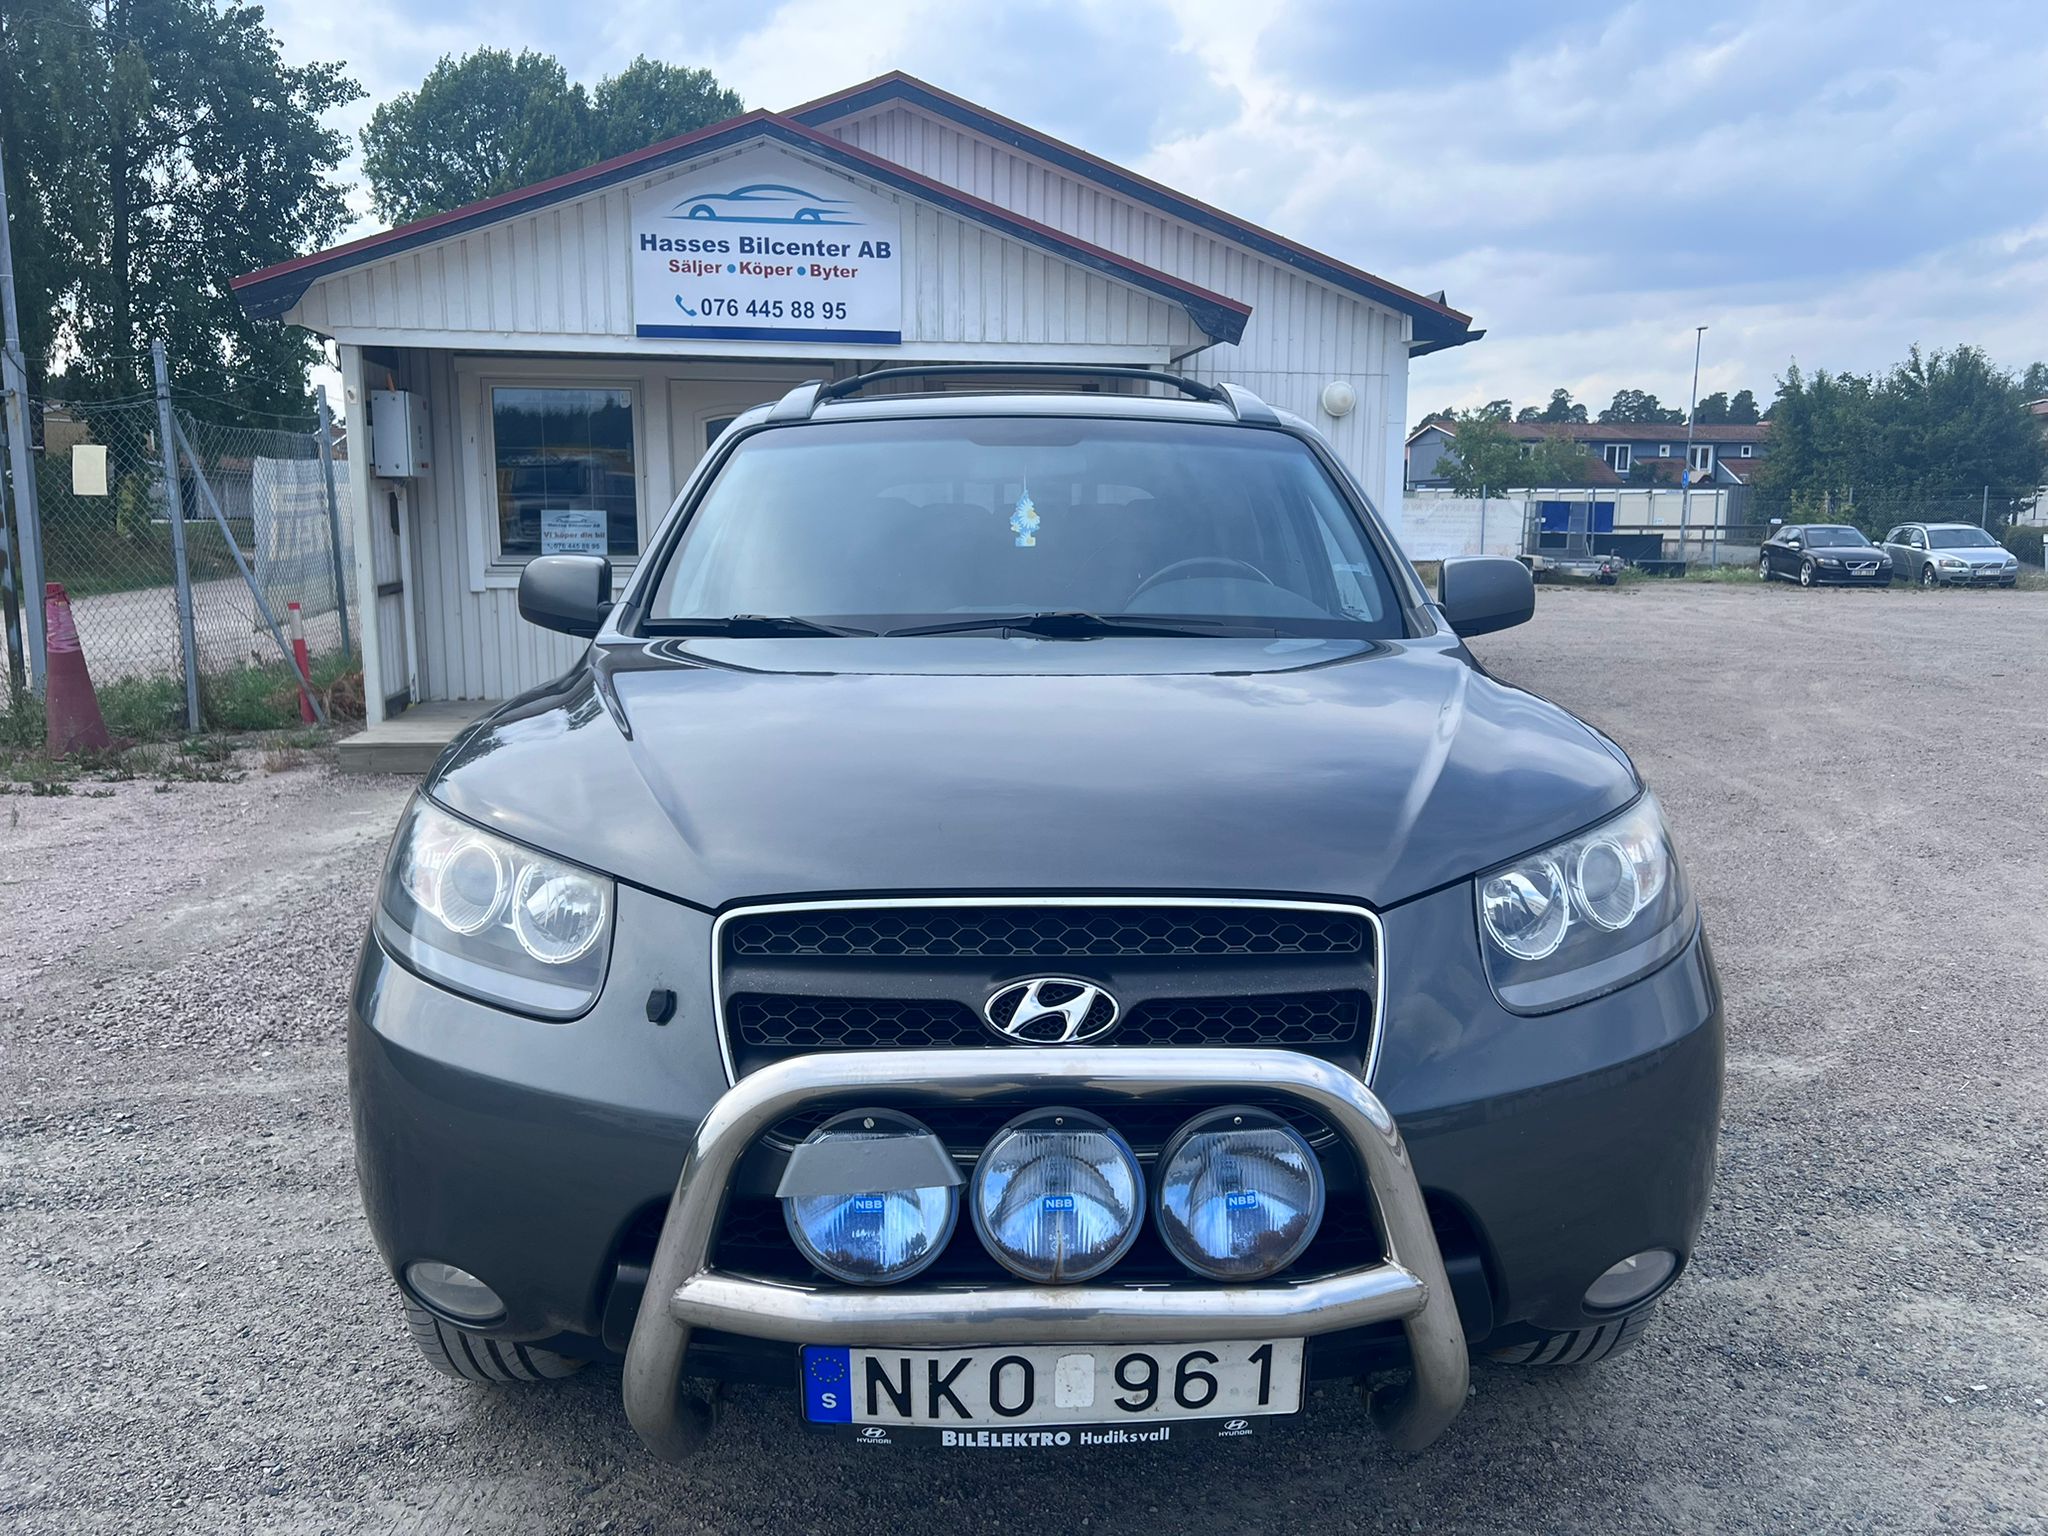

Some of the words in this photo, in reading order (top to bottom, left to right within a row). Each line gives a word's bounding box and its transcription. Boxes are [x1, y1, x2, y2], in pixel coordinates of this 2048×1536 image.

[639, 233, 730, 253] Hasses
[738, 236, 851, 258] Bilcenter
[858, 241, 891, 259] AB
[668, 259, 722, 277] Säljer
[739, 260, 793, 279] Köper
[809, 263, 858, 281] Byter
[700, 298, 738, 317] 076
[745, 299, 783, 318] 445
[790, 301, 814, 319] 88
[822, 302, 847, 320] 95
[855, 1199, 883, 1210] NBB
[1045, 1198, 1073, 1209] NBB
[1228, 1195, 1255, 1207] NBB
[865, 1355, 1035, 1419] NKO
[1113, 1343, 1275, 1413] 961
[821, 1392, 837, 1409] S
[856, 1436, 892, 1445] HYUNDAI
[941, 1429, 1071, 1447] BILELEKTRO
[1080, 1426, 1170, 1446] Hudiksvall
[1218, 1428, 1253, 1437] HYUNDAI
